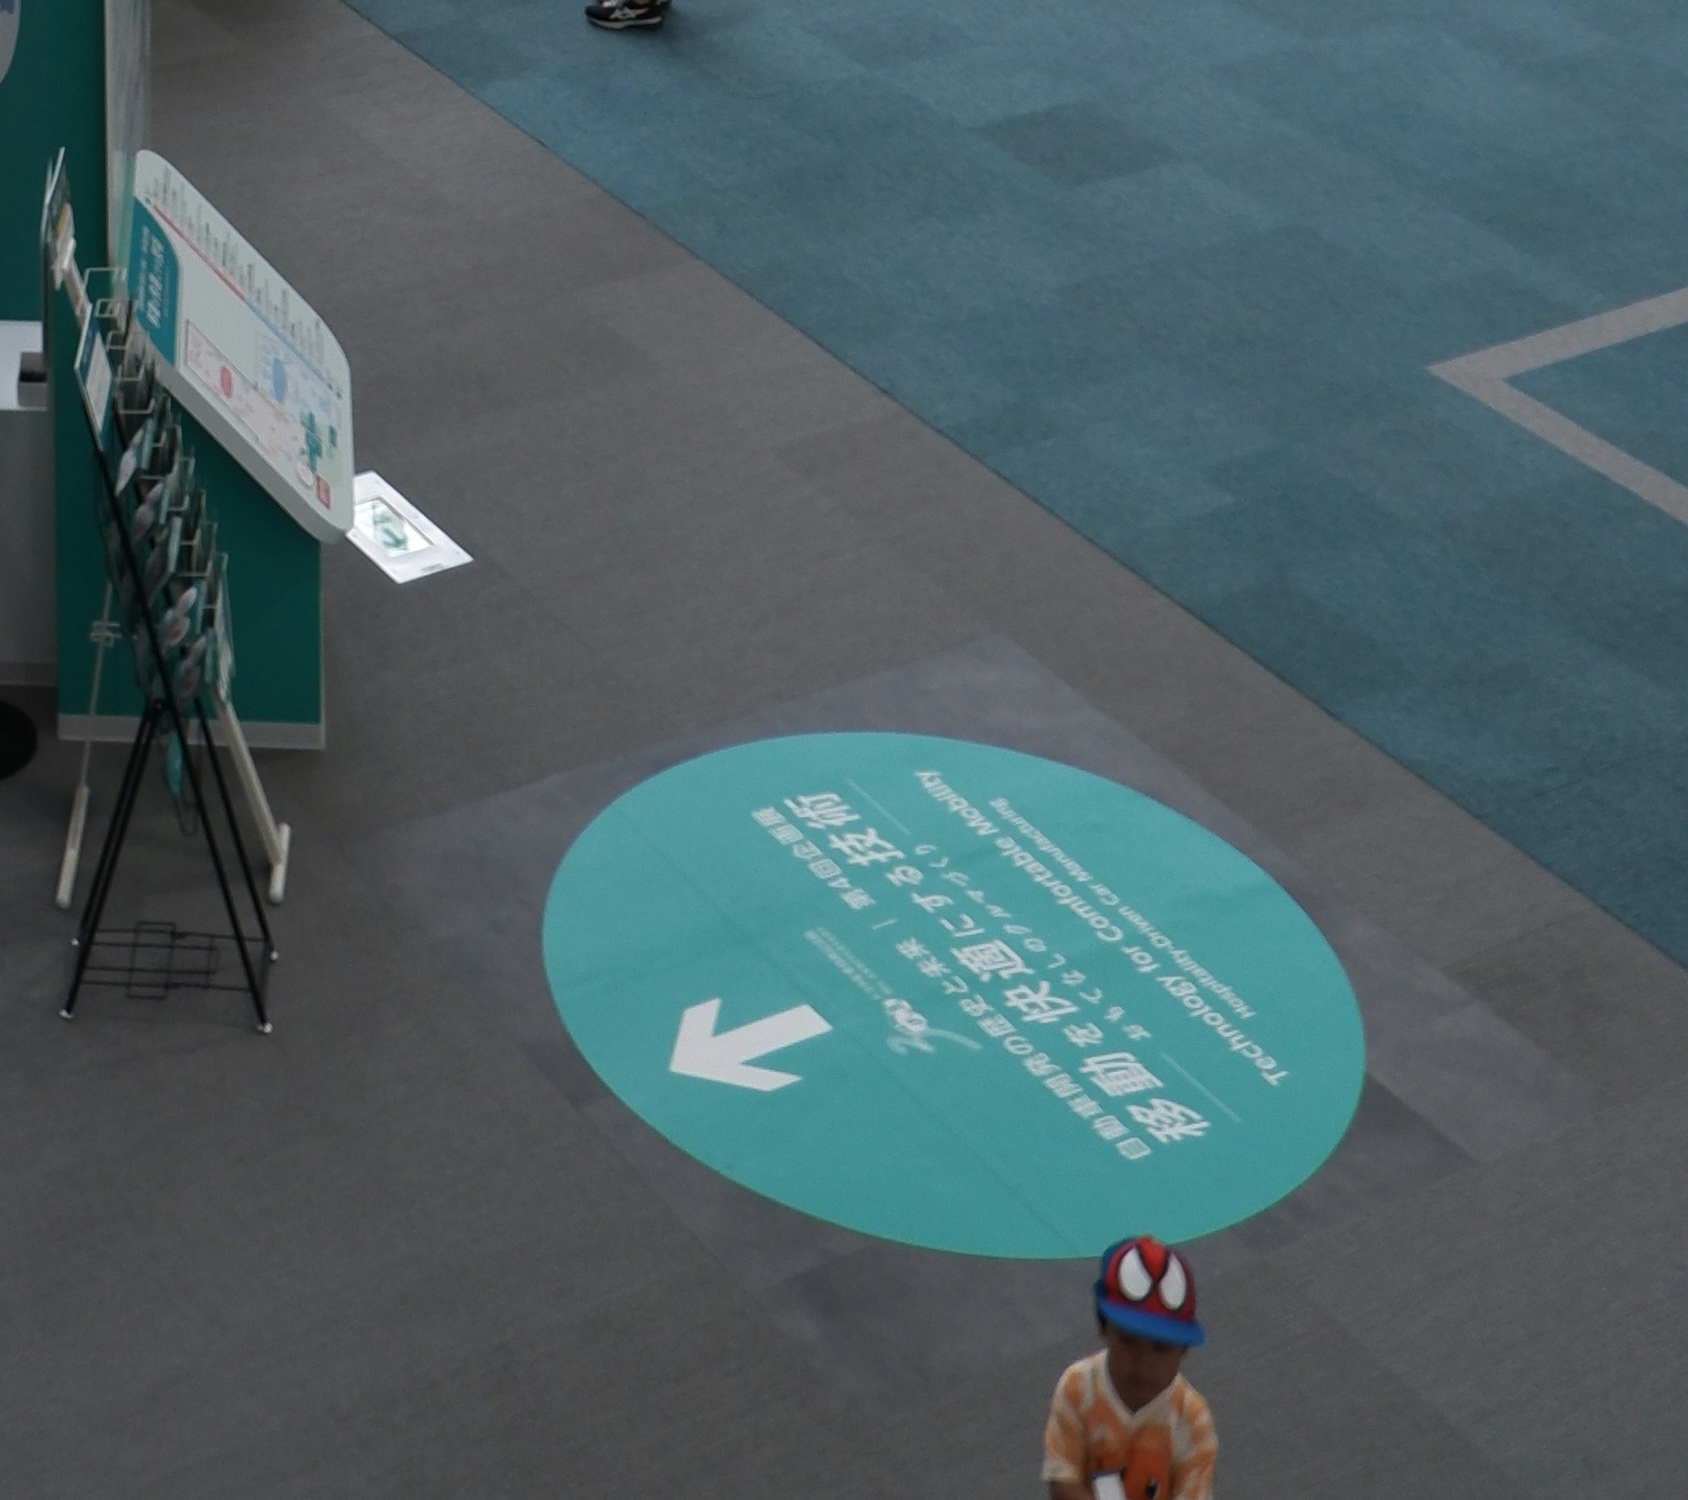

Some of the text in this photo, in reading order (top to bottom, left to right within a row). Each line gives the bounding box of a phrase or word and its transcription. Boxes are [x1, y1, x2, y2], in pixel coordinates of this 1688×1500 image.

[751, 805, 876, 910] 第4回企画展
[783, 792, 1211, 1143] 移動を快適にする技術
[914, 843, 1152, 1042] おもてなしのクルマづくり
[916, 769, 1290, 1087] Technology for Comfortable Mobility
[989, 796, 1255, 1019] Hospitality-Driven Car Manufacturing
[896, 937, 1151, 1160] 自動車開発の歴史と未来
